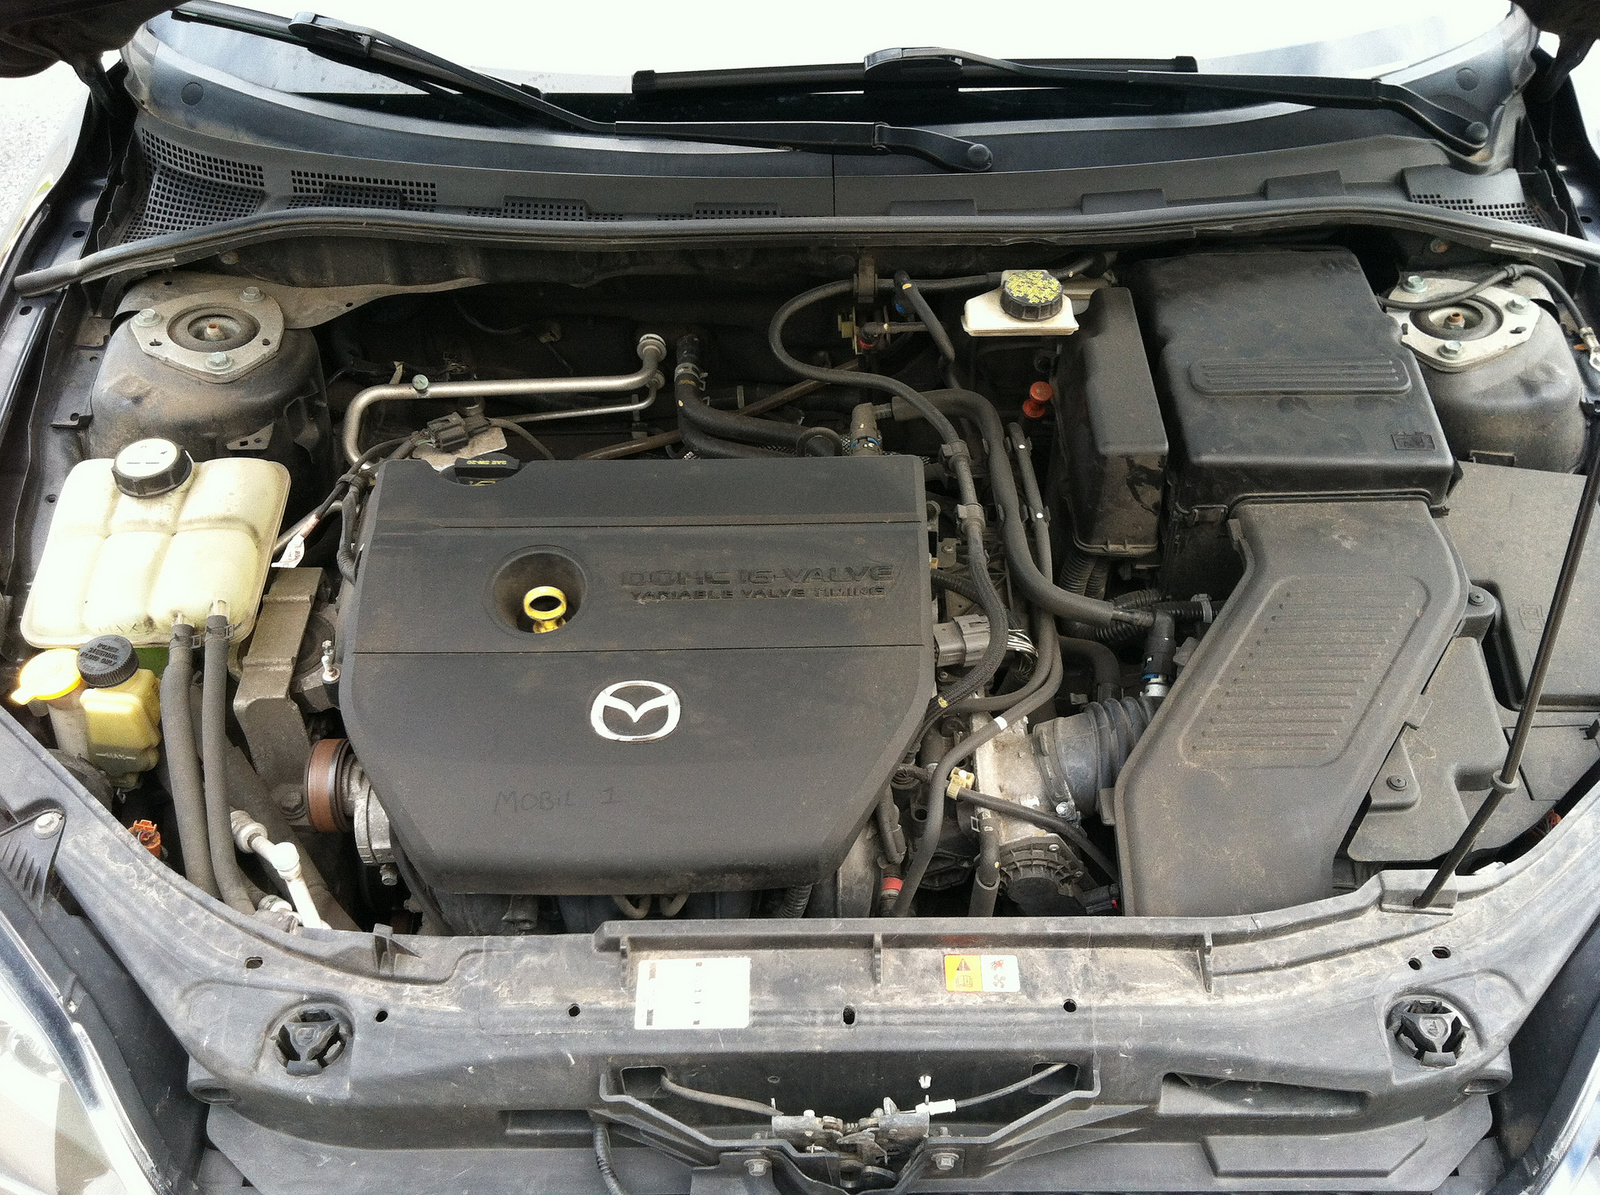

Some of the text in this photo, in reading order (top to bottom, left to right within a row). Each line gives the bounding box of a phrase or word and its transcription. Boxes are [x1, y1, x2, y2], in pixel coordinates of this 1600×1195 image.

[620, 570, 732, 588] DOHC
[630, 586, 887, 604] VARIABLE VALVE TIMING
